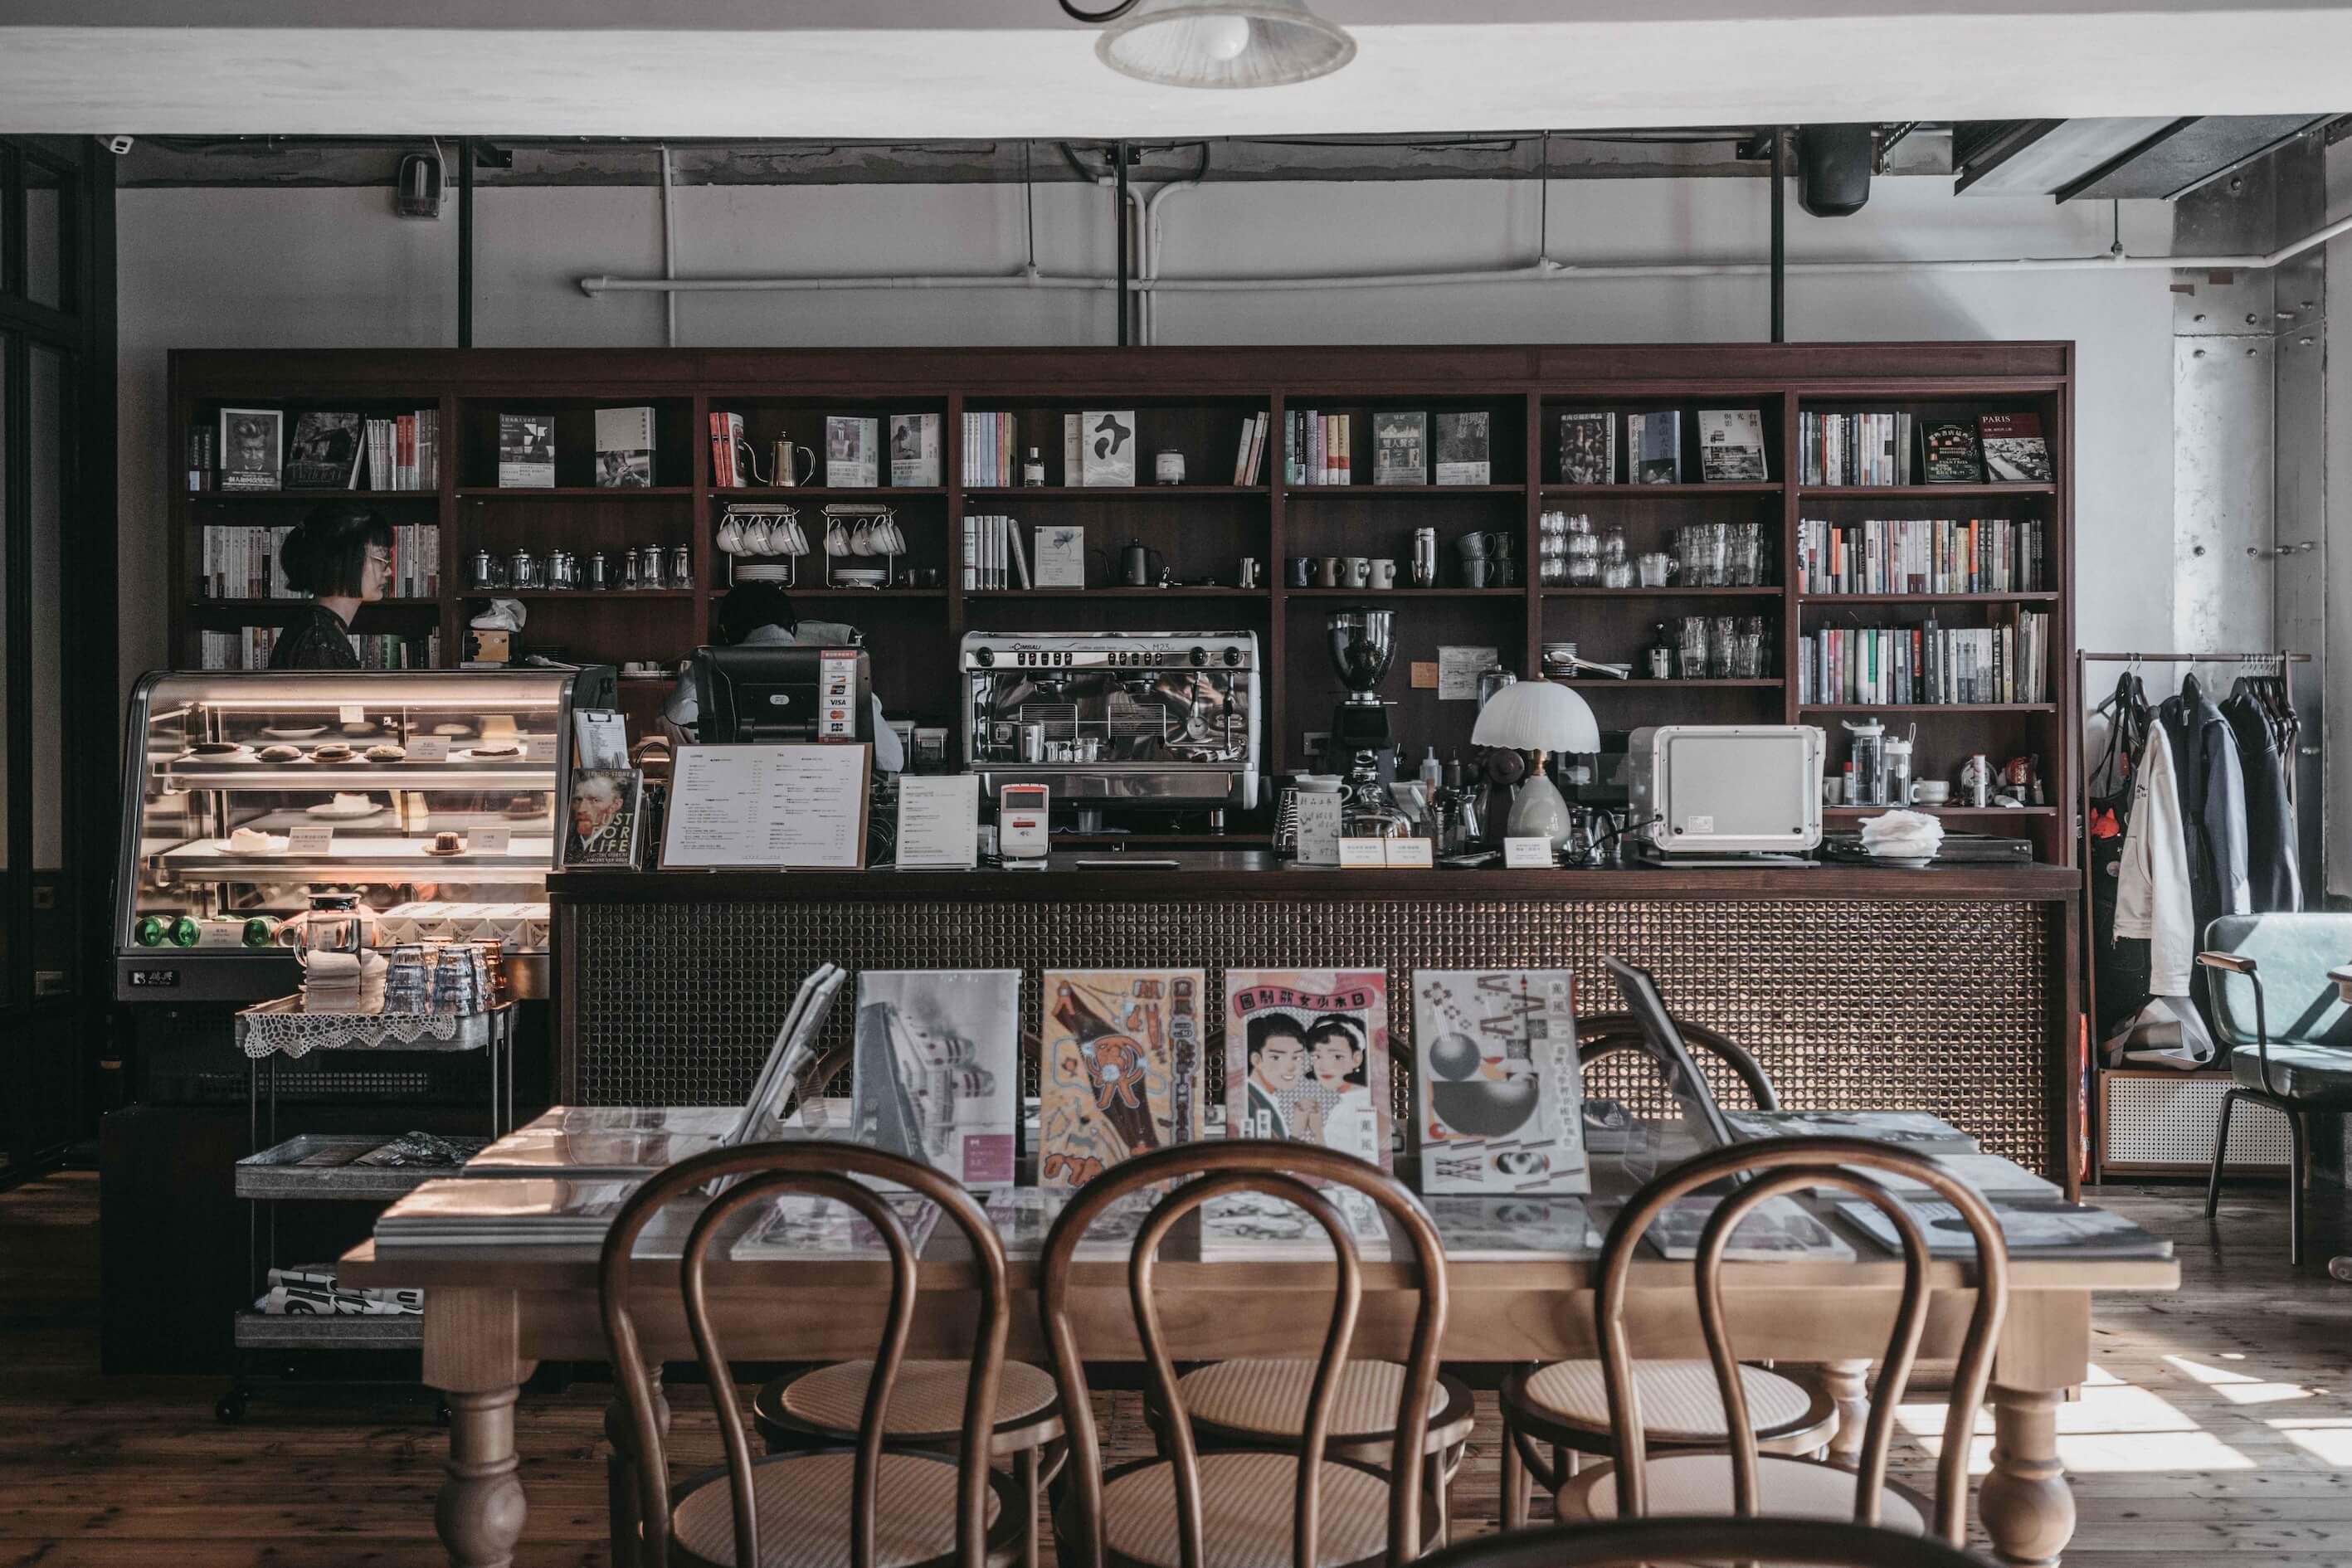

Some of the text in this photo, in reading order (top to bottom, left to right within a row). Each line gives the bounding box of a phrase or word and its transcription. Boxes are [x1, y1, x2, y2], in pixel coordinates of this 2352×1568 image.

[592, 813, 634, 825] LUST
[591, 826, 631, 840] FOR
[589, 839, 629, 853] LIFE
